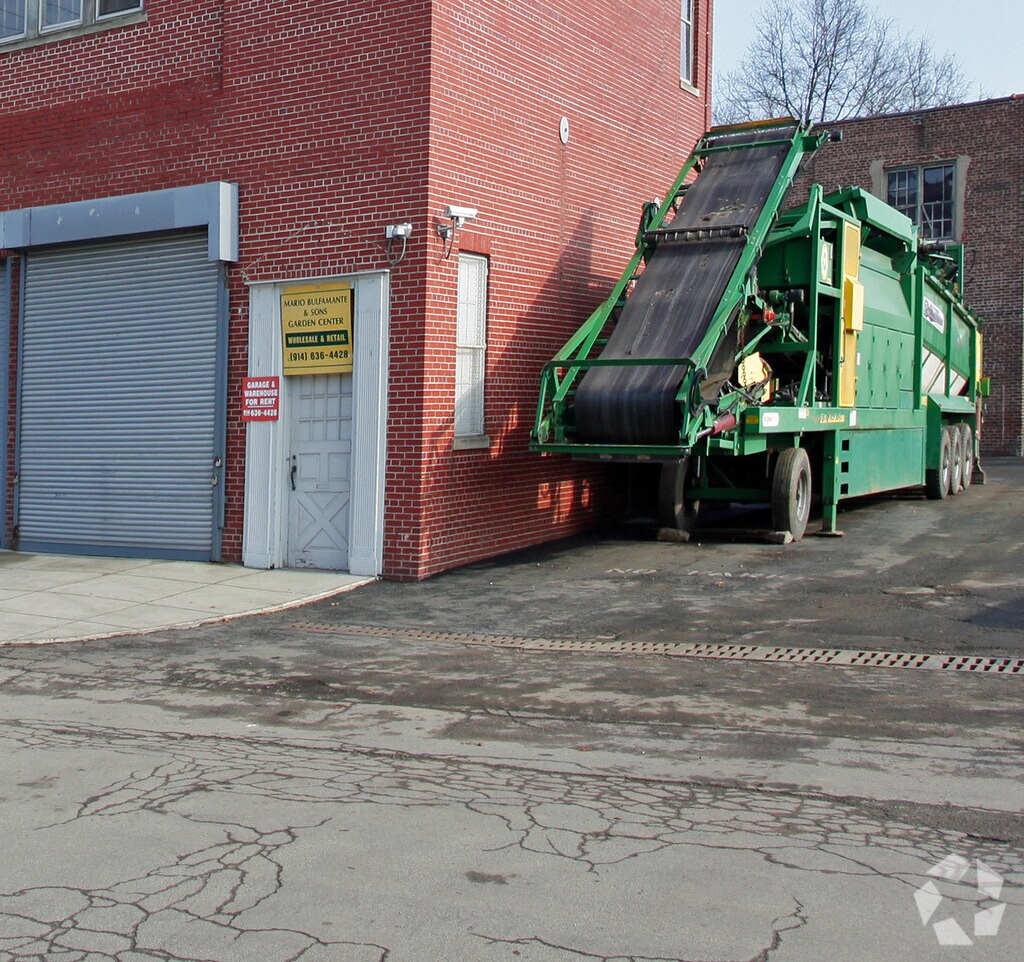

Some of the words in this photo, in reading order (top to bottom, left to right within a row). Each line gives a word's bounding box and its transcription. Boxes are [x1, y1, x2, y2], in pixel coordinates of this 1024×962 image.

[284, 299, 305, 307] MARIO
[307, 295, 348, 305] BULFAMANTE
[311, 307, 328, 316] SONS
[288, 319, 316, 328] GARDEN
[318, 317, 344, 326] CENTER
[288, 335, 318, 344] WHOLESALE
[326, 334, 346, 342] RETAIL
[289, 352, 308, 361] (914)
[310, 350, 349, 360] 636-4428
[247, 381, 270, 389] GARAGE
[244, 389, 278, 398] WAREHOUSE
